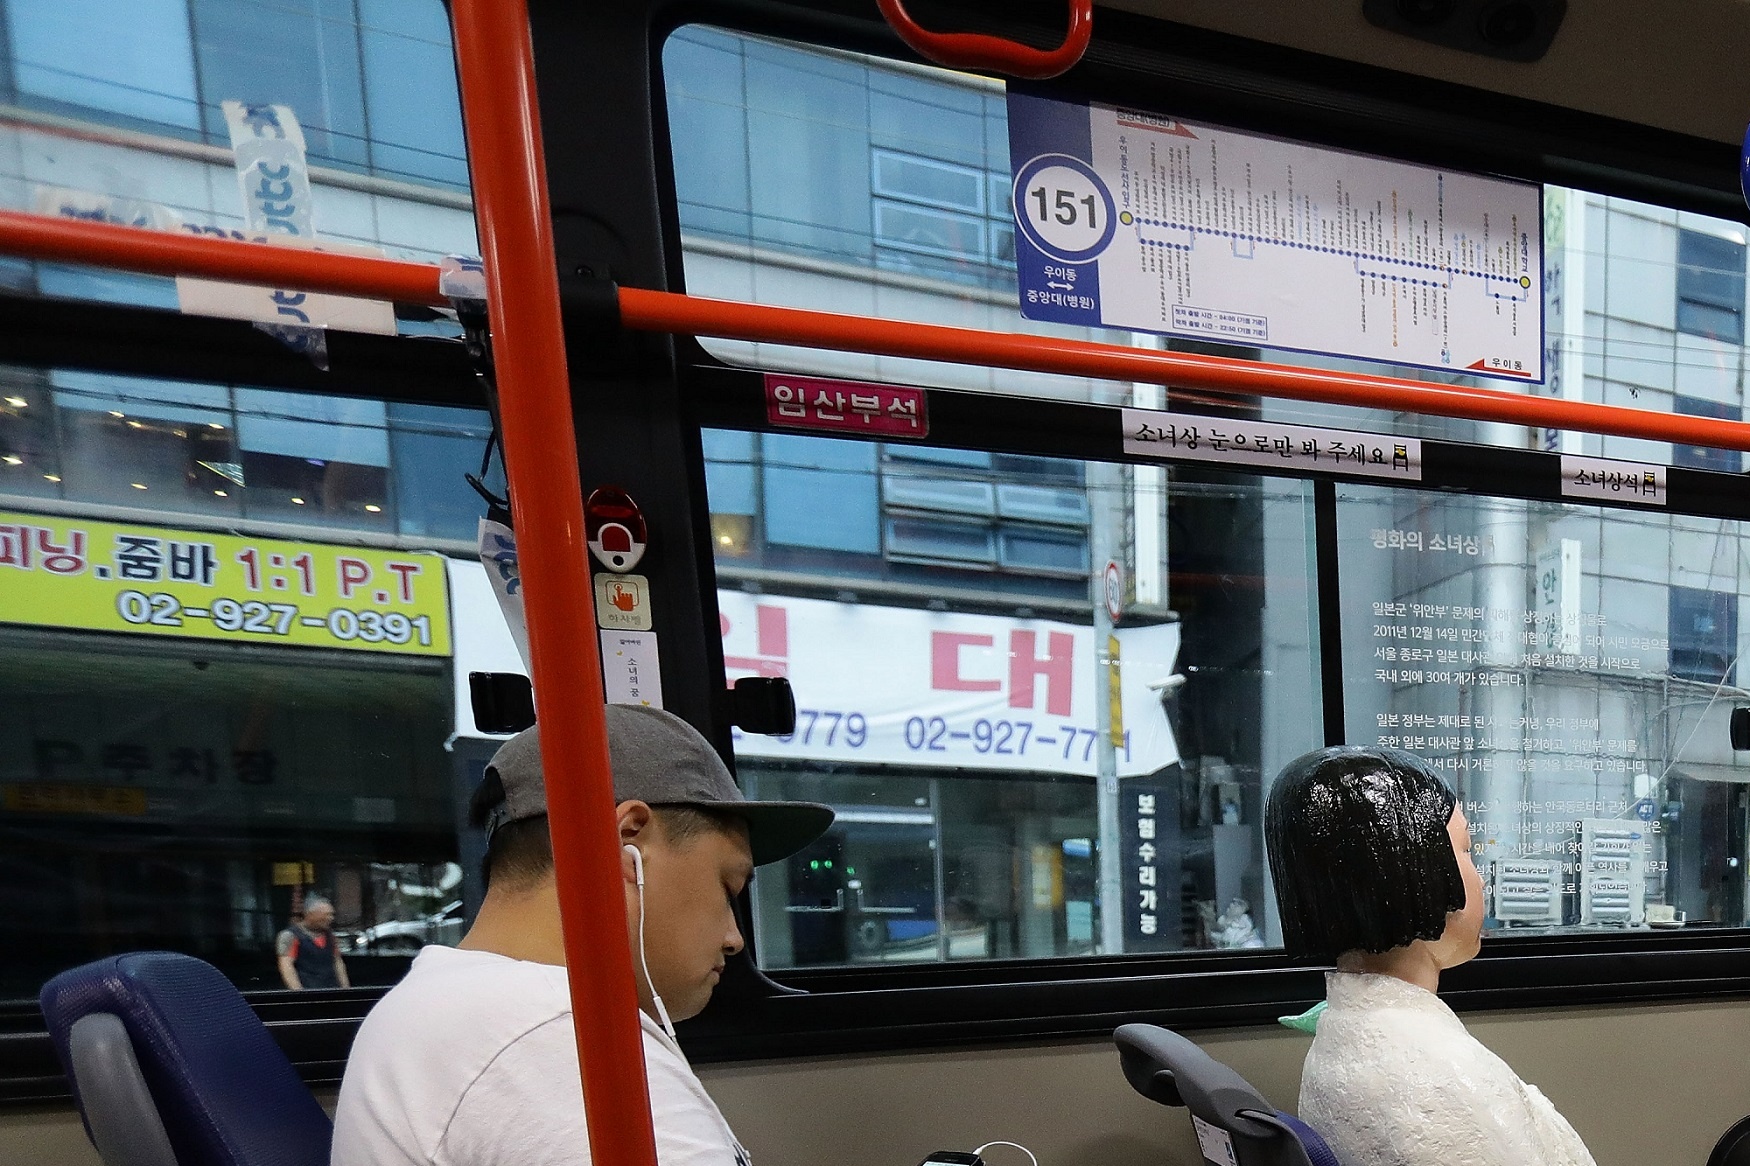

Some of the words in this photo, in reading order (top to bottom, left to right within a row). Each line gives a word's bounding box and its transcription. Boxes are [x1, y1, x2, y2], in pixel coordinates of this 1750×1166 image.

[1031, 186, 1097, 229] 151
[1044, 265, 1078, 282] 우이동
[1026, 289, 1095, 310] 중앙대(병원)
[1491, 357, 1523, 371] 우이동
[773, 384, 919, 428] 임산부석
[1134, 422, 1201, 450] 소녀상
[1208, 429, 1294, 457] 눈으로만
[1300, 438, 1321, 461] 봐
[1327, 441, 1389, 467] 주세요
[1574, 469, 1639, 494] 소녀상석
[1370, 529, 1423, 551] 평화의
[1428, 533, 1480, 556] 소녀상
[237, 546, 317, 596] 1:1
[338, 557, 421, 604] P.T
[116, 589, 431, 646] 02-927-0391
[1372, 602, 1407, 617] 일본군
[1451, 606, 1485, 621] 문제의
[1373, 625, 1407, 640] 2011년
[1410, 626, 1433, 641] 12월
[1436, 628, 1458, 642] 14일
[1373, 647, 1397, 662] 서울
[1399, 648, 1434, 663] 종로구
[1436, 649, 1459, 664] 일본
[1521, 652, 1542, 667] 처음
[1544, 654, 1576, 669] 설치한
[1578, 655, 1599, 669] 것을
[1601, 657, 1642, 671] 시작으로
[1374, 669, 1397, 683] 국내
[1400, 670, 1423, 684] 외에
[1426, 671, 1451, 685] 30여
[1453, 672, 1476, 685] 개가
[1479, 672, 1524, 687] 있습니다.
[1376, 713, 1400, 728] 일본
[1401, 714, 1436, 728] 정부는
[1438, 715, 1471, 729] 제대로
[1473, 715, 1485, 729] 된
[1545, 717, 1566, 731] 우리
[1568, 718, 1599, 732] 정부에
[1376, 735, 1401, 749] 주한
[1402, 736, 1426, 750] 일본
[1428, 736, 1461, 750] 대사관
[1463, 737, 1475, 750] 앞
[1446, 758, 1469, 772] 다시
[1606, 760, 1648, 774] 있습니다.
[1137, 793, 1158, 936] 보험수리가능
